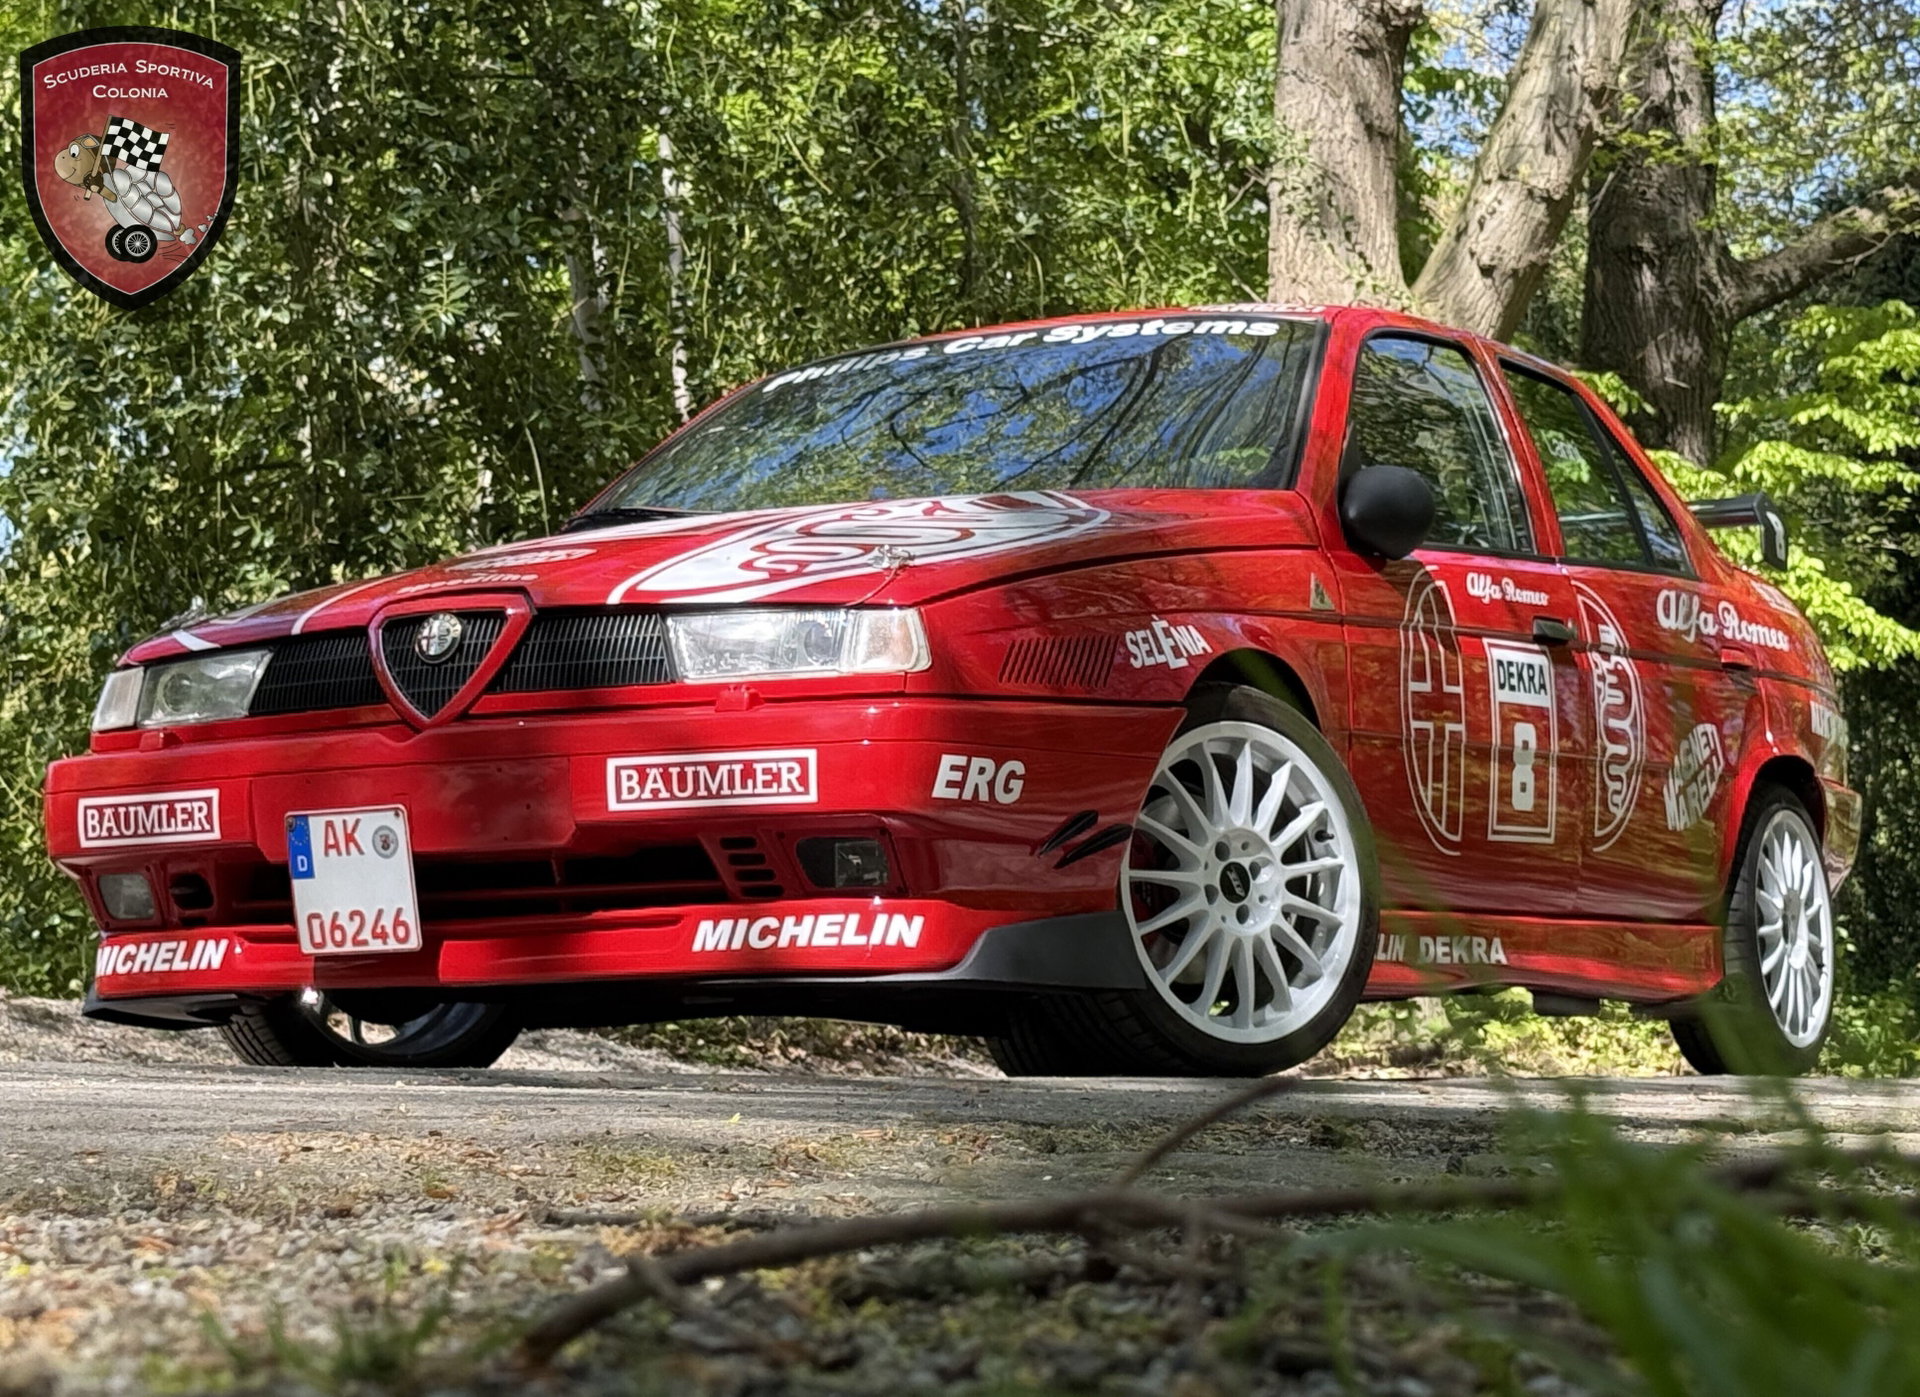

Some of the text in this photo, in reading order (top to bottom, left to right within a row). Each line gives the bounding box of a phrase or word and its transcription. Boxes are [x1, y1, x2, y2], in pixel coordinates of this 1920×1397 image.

[943, 332, 1037, 354] Car
[1043, 319, 1280, 344] Systems
[1656, 589, 1719, 644] Alfa
[1496, 659, 1549, 696] DEKRA
[619, 761, 805, 799] BÄUMLER
[931, 753, 1026, 805] ERG
[1512, 722, 1537, 812] 8
[324, 818, 365, 857] AK
[297, 855, 308, 872] D
[307, 907, 411, 950] 06246
[692, 912, 924, 952] MICHELIN
[1418, 935, 1508, 966] DEKRA
